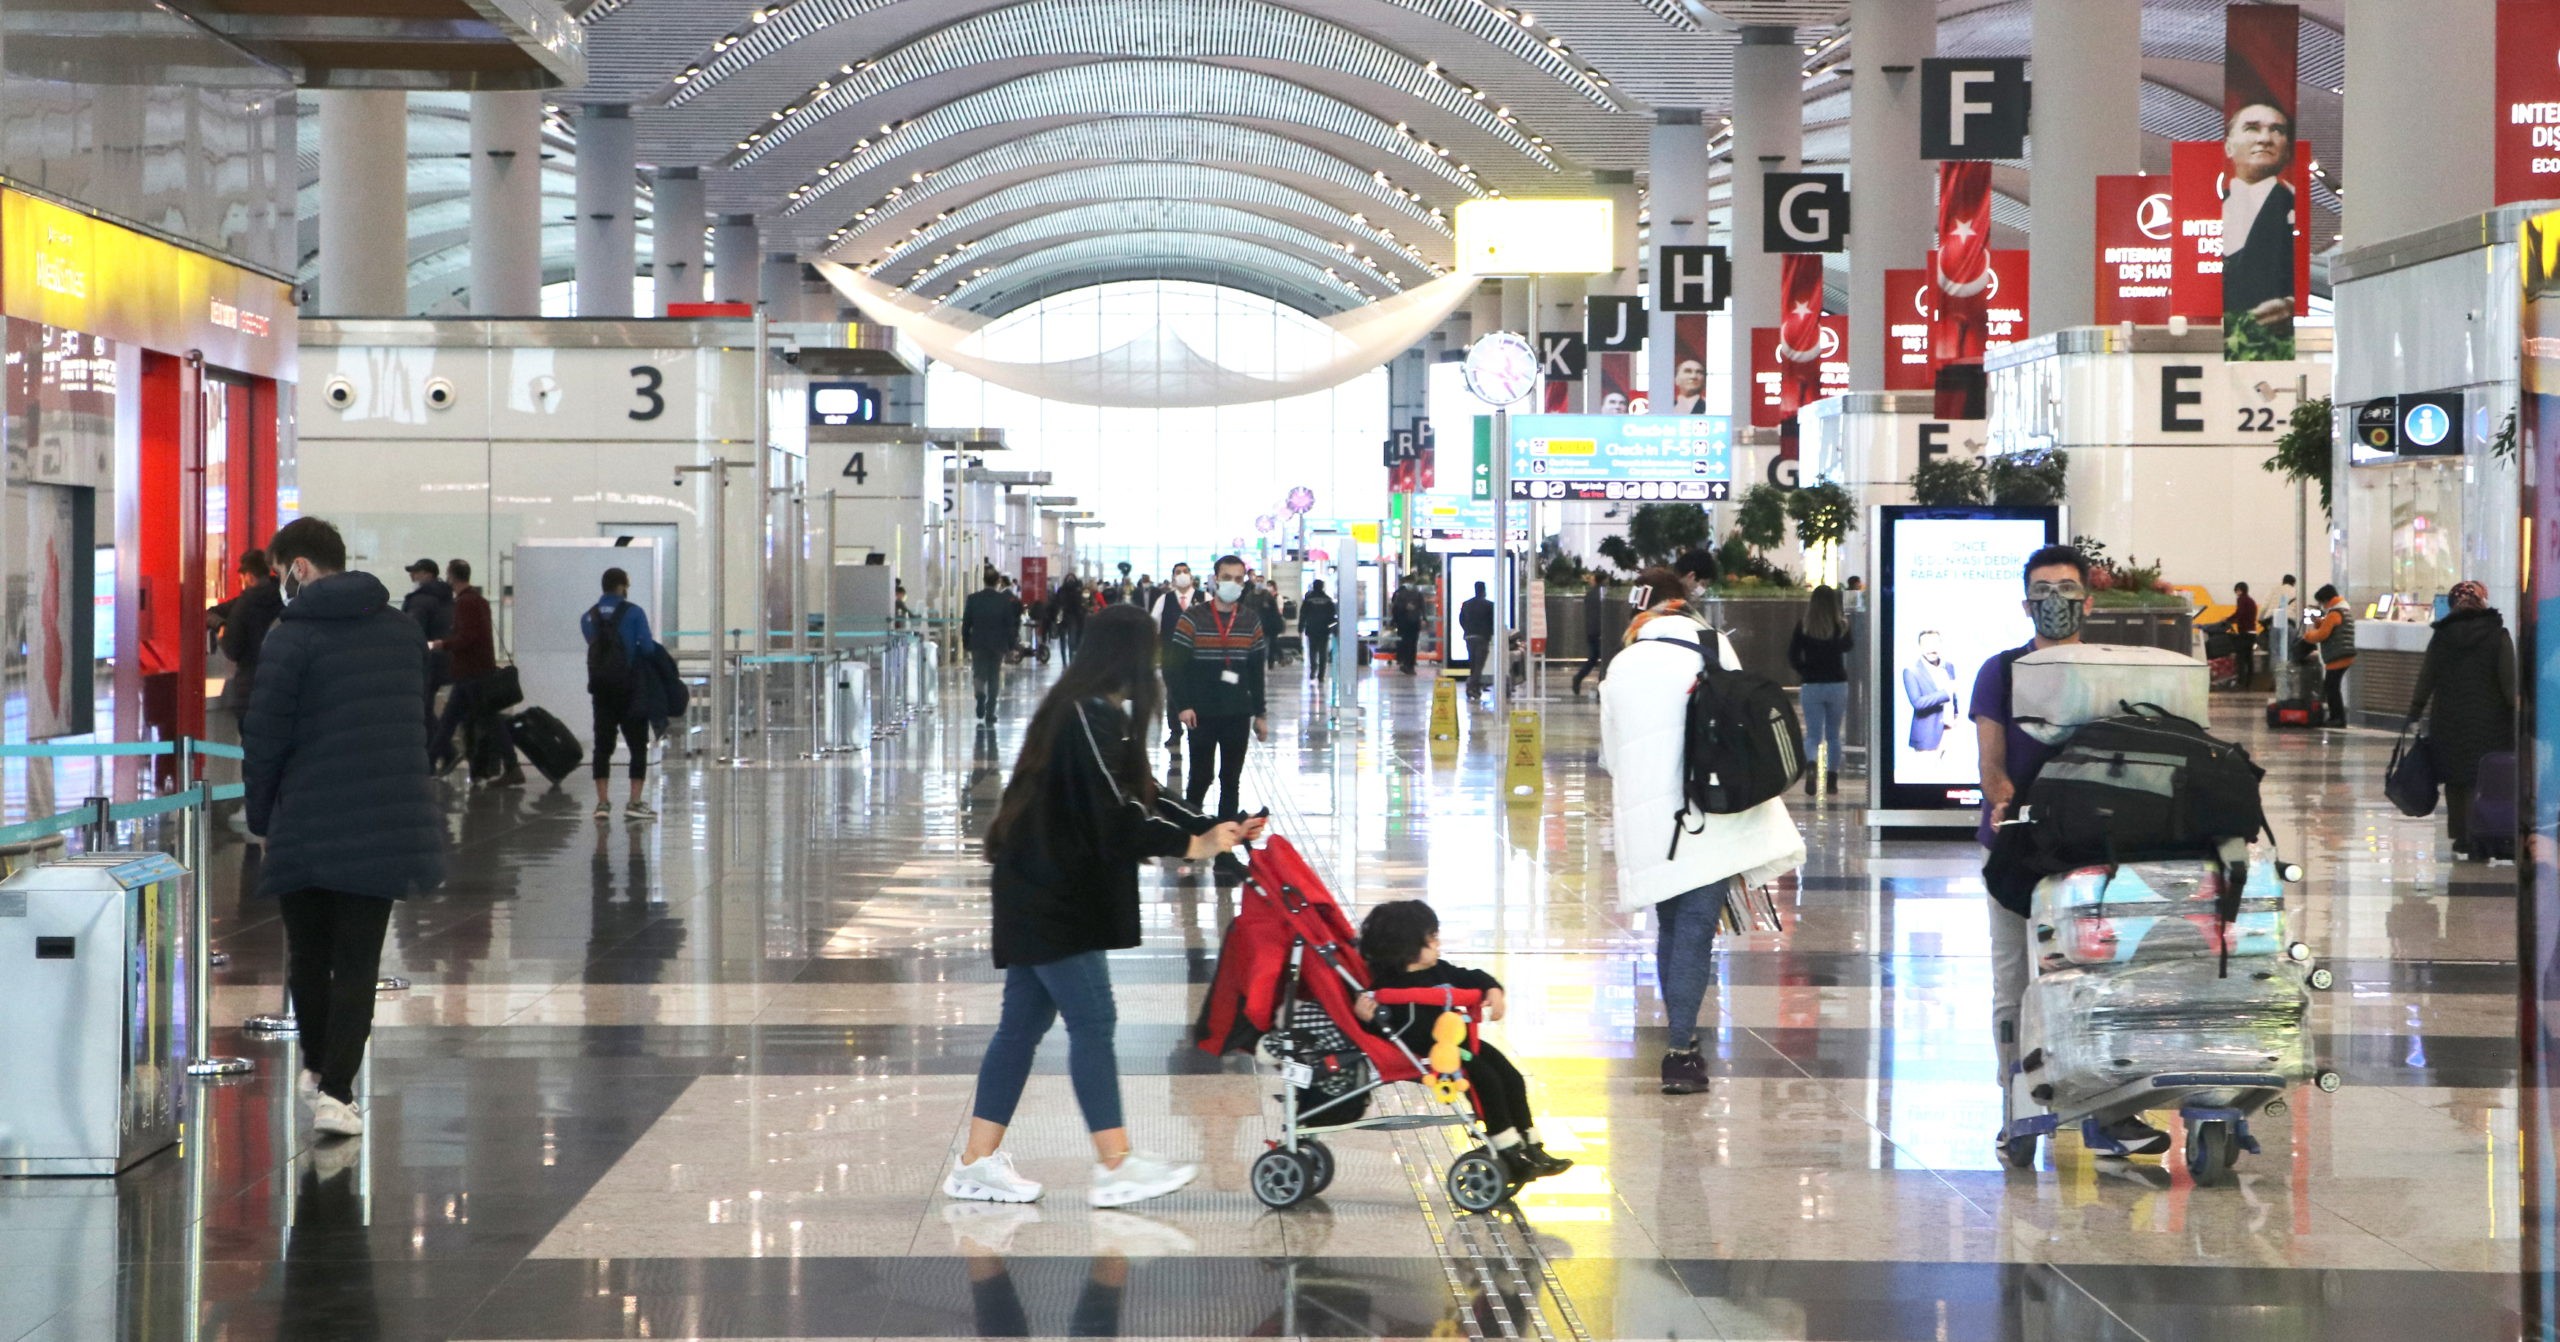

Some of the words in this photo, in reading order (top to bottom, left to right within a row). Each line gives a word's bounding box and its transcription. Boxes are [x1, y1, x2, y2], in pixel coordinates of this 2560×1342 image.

[1950, 70, 1995, 146] F
[2511, 103, 2560, 124] INTE
[1778, 182, 1830, 243] G
[1673, 254, 1713, 304] H
[2118, 264, 2144, 282] DIŞ
[1605, 302, 1628, 346] J
[1544, 337, 1572, 376] K
[628, 365, 665, 421] 3
[2161, 366, 2204, 432] E
[2237, 407, 2289, 432] 22-
[1399, 432, 1416, 456] R
[1418, 419, 1434, 445] P
[1622, 423, 1677, 437] Check-in
[1605, 442, 1659, 456] Check-in
[841, 452, 868, 485] 4
[1767, 455, 1800, 492] G
